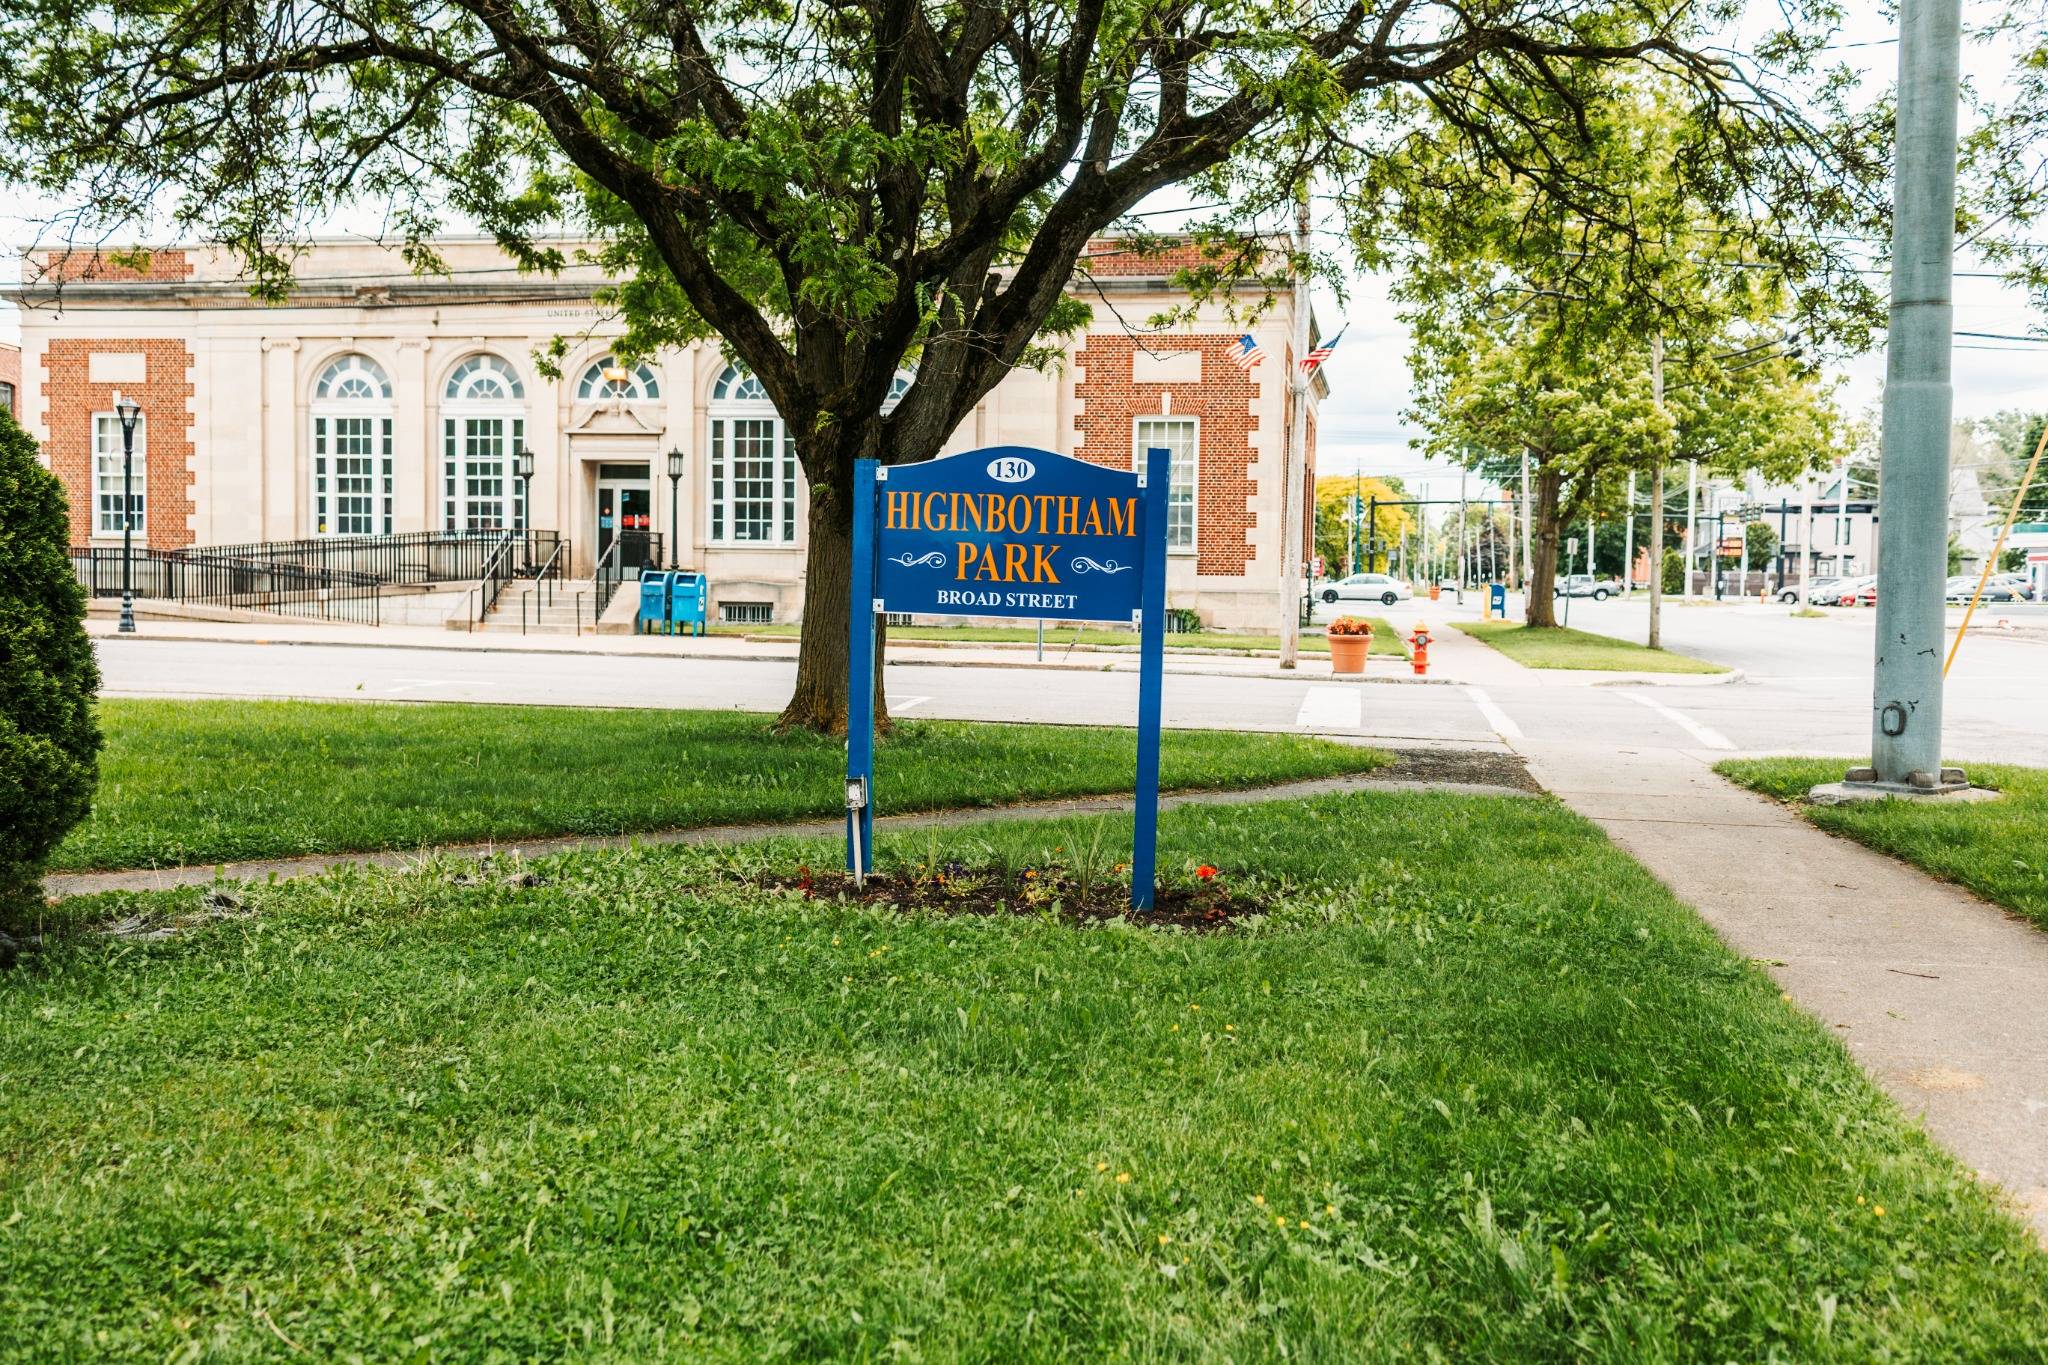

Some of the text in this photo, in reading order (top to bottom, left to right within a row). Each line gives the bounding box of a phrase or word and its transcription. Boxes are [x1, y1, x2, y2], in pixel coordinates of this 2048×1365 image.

[546, 309, 580, 317] UNITED
[995, 461, 1028, 478] 130
[885, 491, 1138, 537] HIGINBOTHAM
[954, 541, 1061, 584] PARK
[937, 589, 1078, 609] BROAD STREET
